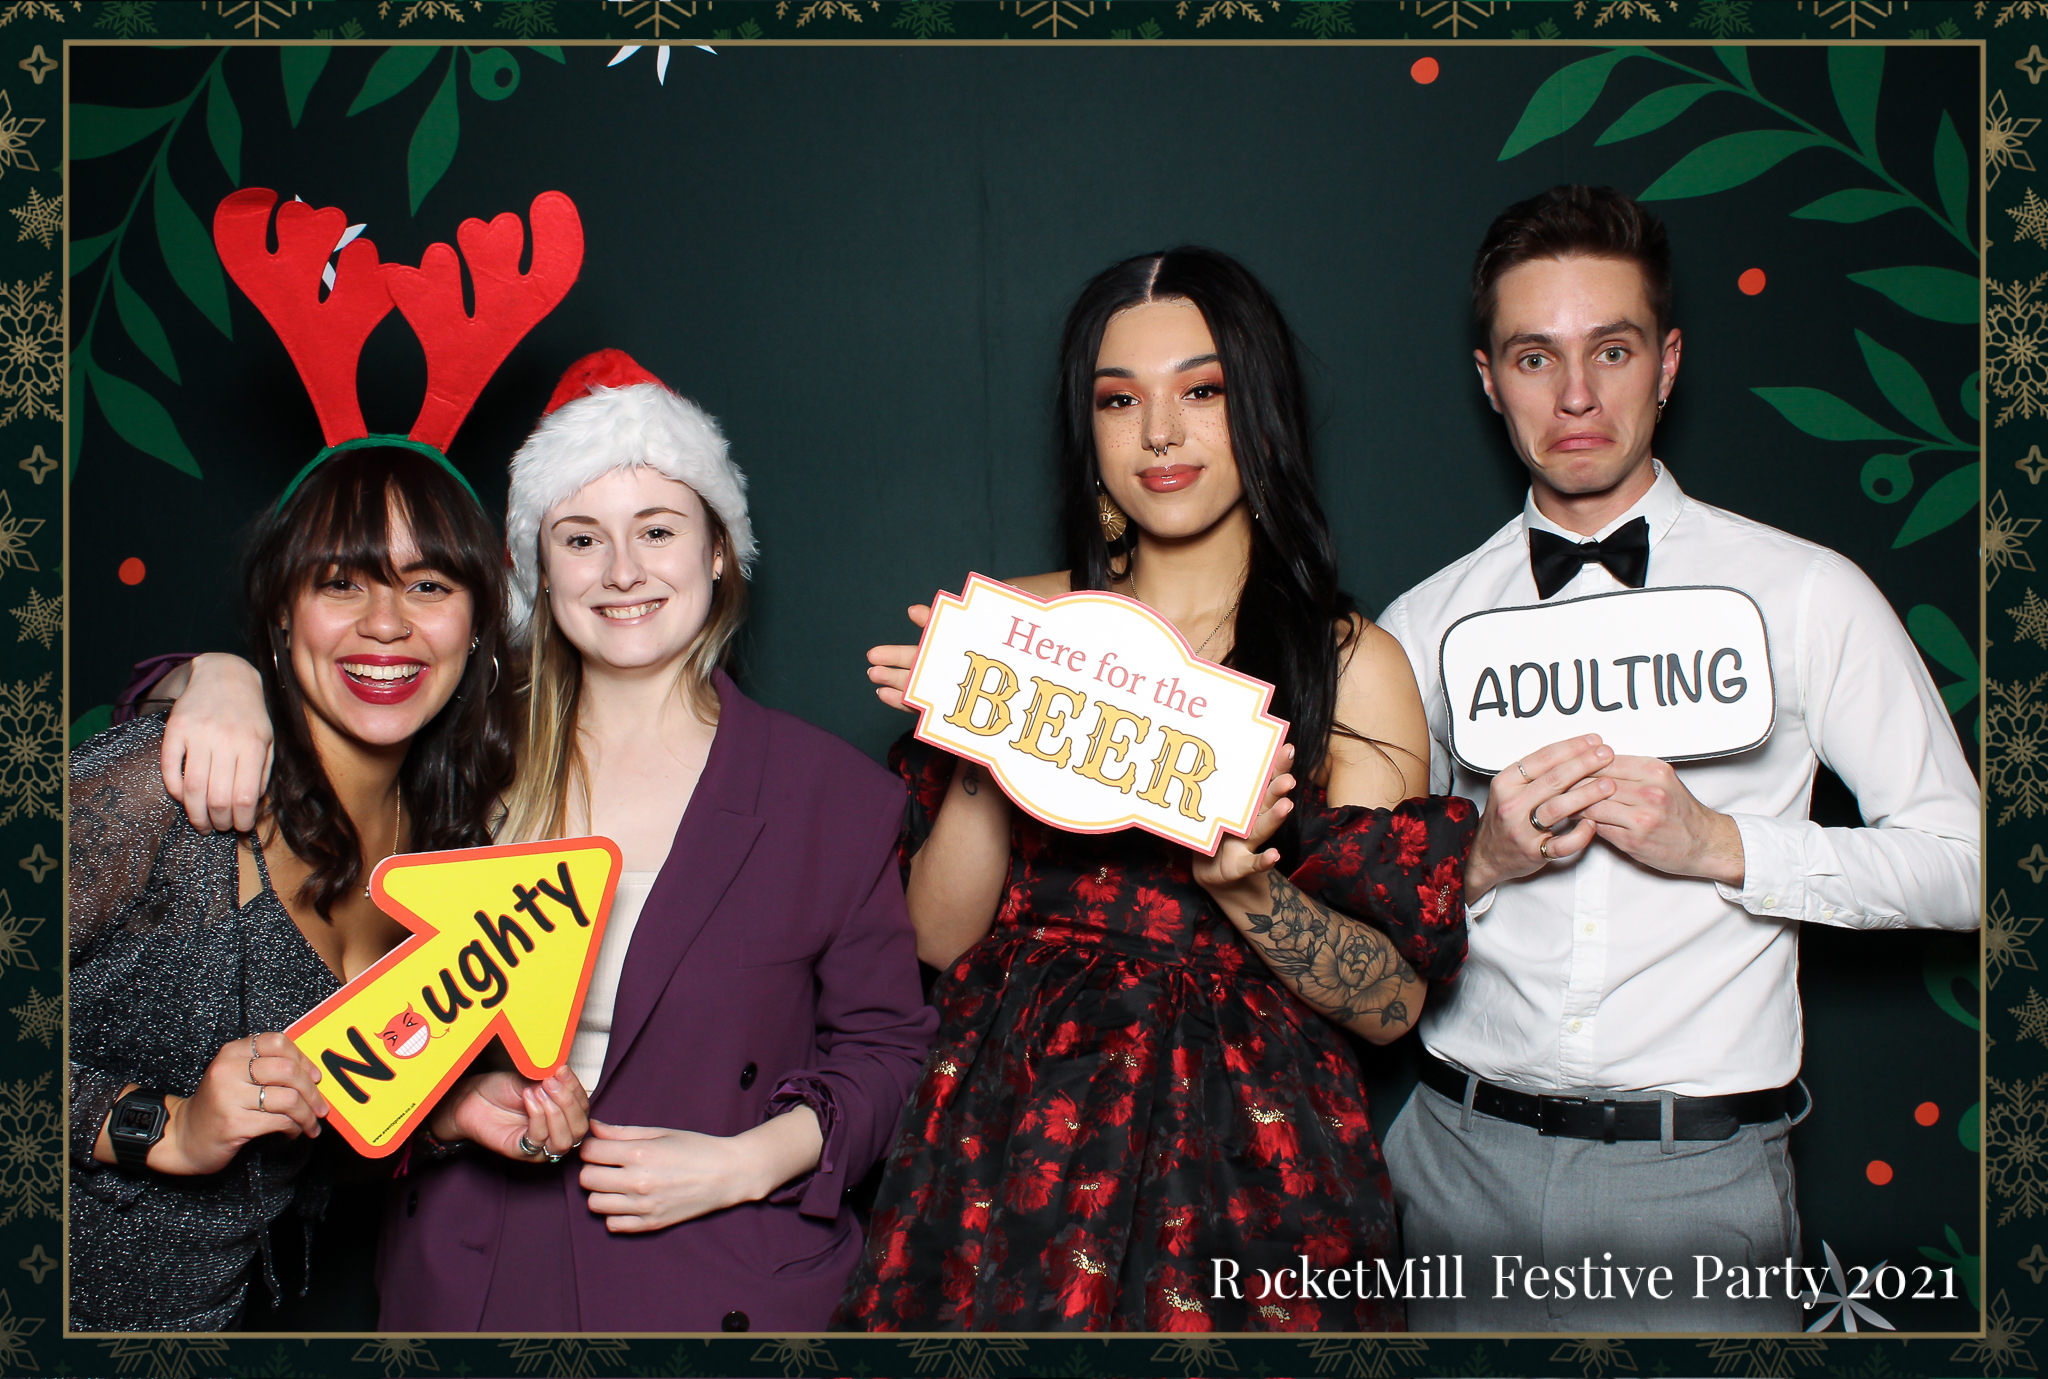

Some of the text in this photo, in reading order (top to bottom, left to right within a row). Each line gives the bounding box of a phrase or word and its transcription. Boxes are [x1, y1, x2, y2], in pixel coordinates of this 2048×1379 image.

[943, 650, 1218, 822] BEER
[1002, 615, 1208, 719] Here for the
[1469, 647, 1748, 722] ADULTING
[320, 861, 591, 1105] Nughty
